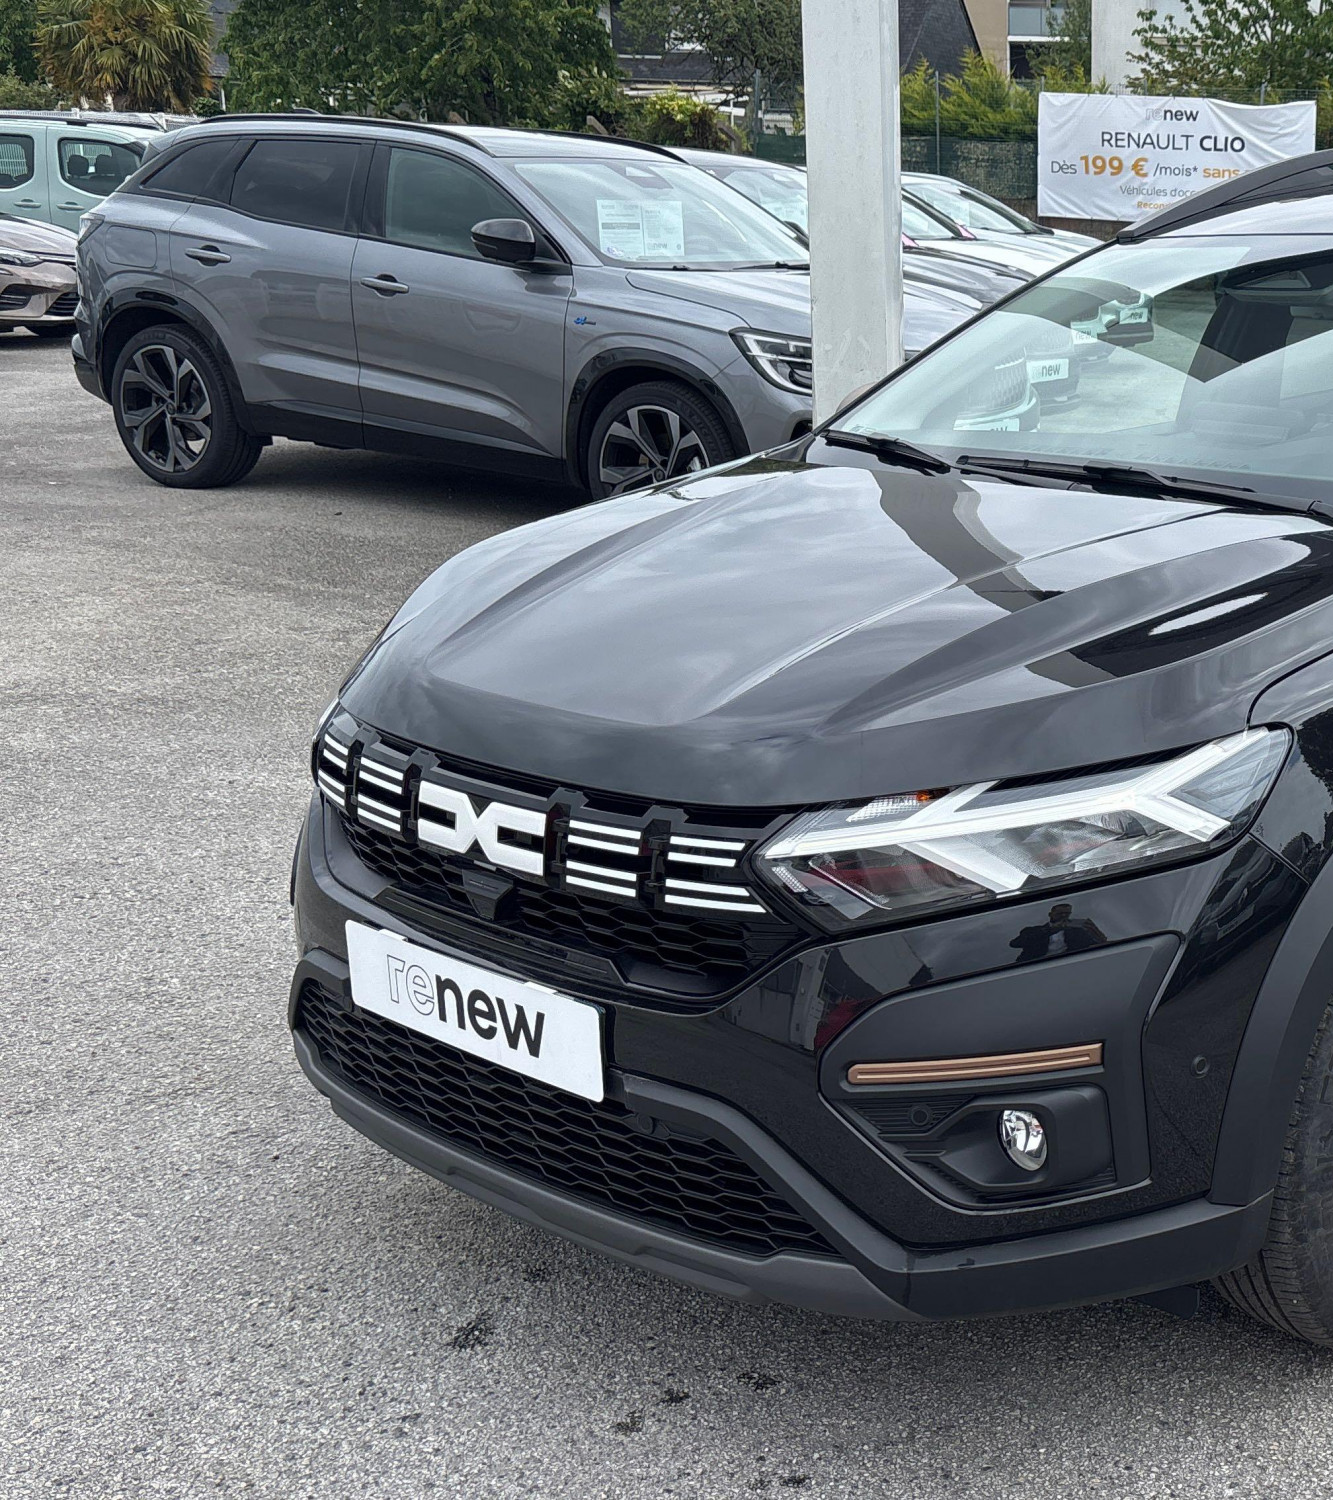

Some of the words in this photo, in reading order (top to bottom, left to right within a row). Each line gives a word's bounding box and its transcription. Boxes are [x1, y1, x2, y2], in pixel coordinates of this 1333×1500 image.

[1145, 108, 1199, 121] renew
[1101, 131, 1194, 151] RENAULT
[1200, 135, 1246, 153] CLIO
[1051, 160, 1077, 174] Dès
[1080, 154, 1123, 177] 199
[1131, 157, 1149, 178] €
[1203, 167, 1240, 178] sans
[1120, 185, 1168, 198] Véhicules
[1137, 201, 1171, 210] Recon
[386, 953, 546, 1059] renew
